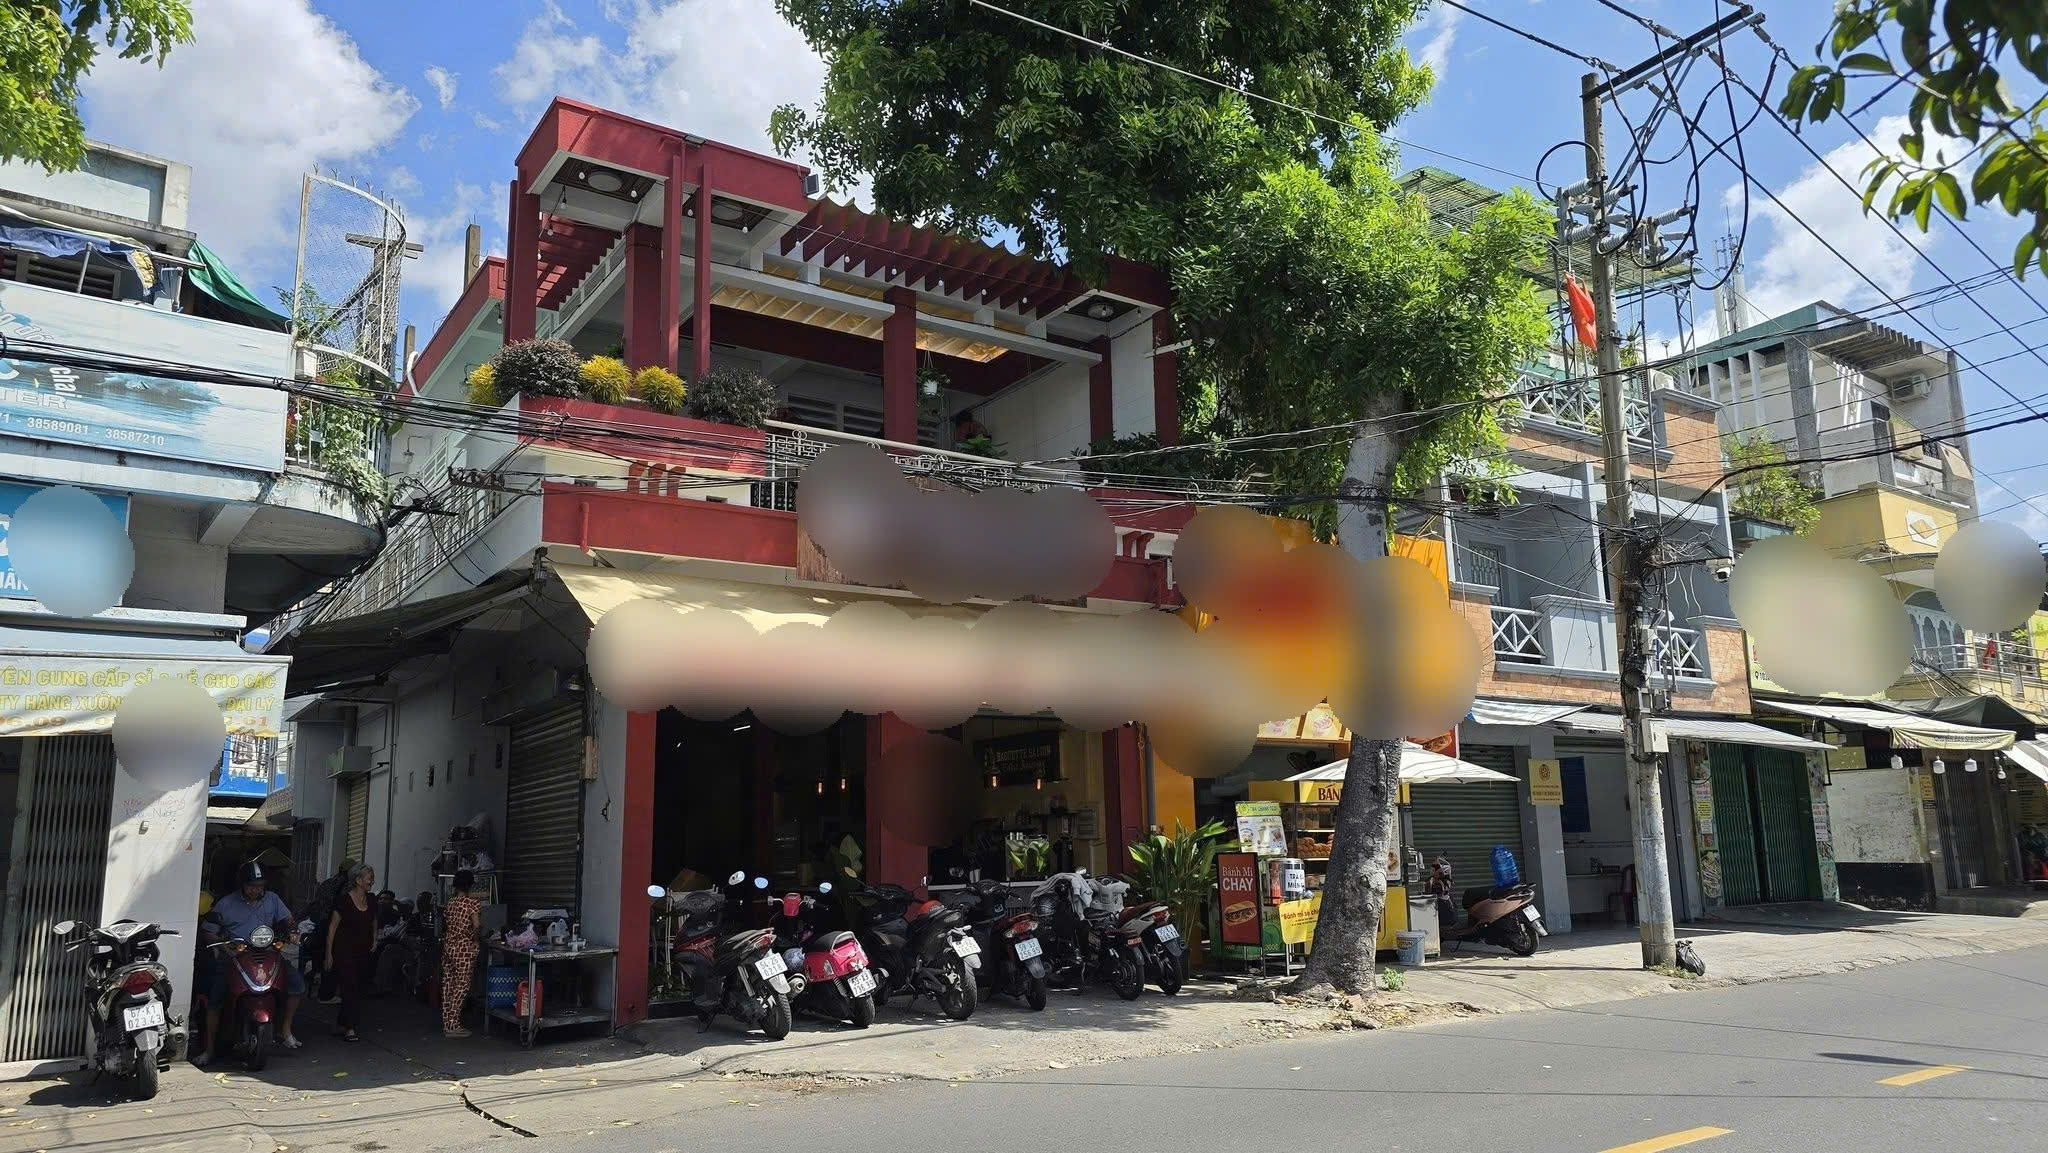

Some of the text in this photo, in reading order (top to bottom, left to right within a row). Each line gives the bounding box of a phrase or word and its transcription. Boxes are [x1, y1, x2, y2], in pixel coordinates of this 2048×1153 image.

[27, 417, 89, 435] 38589081
[105, 428, 165, 446] 38587210
[0, 665, 32, 686] ÊN
[36, 669, 88, 687] CUNG
[92, 664, 130, 688] CẤP
[204, 673, 239, 689] CHO
[243, 671, 276, 689] CÁC
[1318, 783, 1340, 801] BÁN
[1222, 866, 1241, 877] Bánh
[1222, 877, 1253, 891] CHAY
